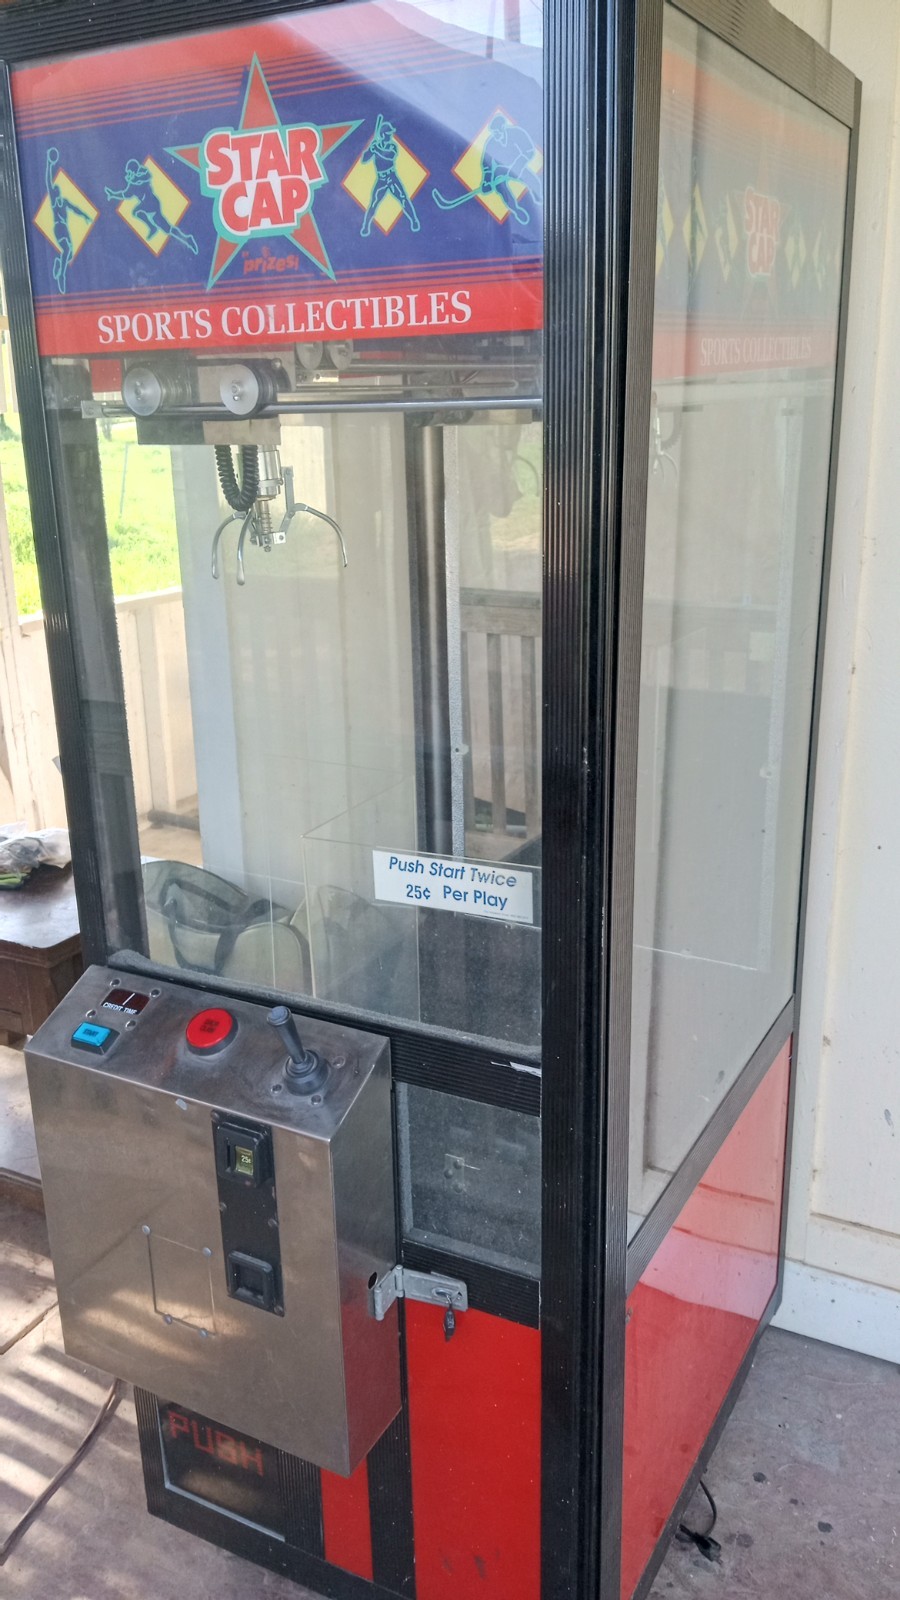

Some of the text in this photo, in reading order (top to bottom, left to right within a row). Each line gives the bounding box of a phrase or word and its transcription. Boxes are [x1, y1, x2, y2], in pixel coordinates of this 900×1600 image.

[205, 126, 323, 187] STAR
[221, 176, 309, 233] CAP
[97, 290, 472, 344] SPORTS COLLECTIBLES
[701, 337, 741, 367] SPORTS
[389, 856, 517, 888] Push Start Twice
[406, 884, 508, 911] 25¢ Per Play
